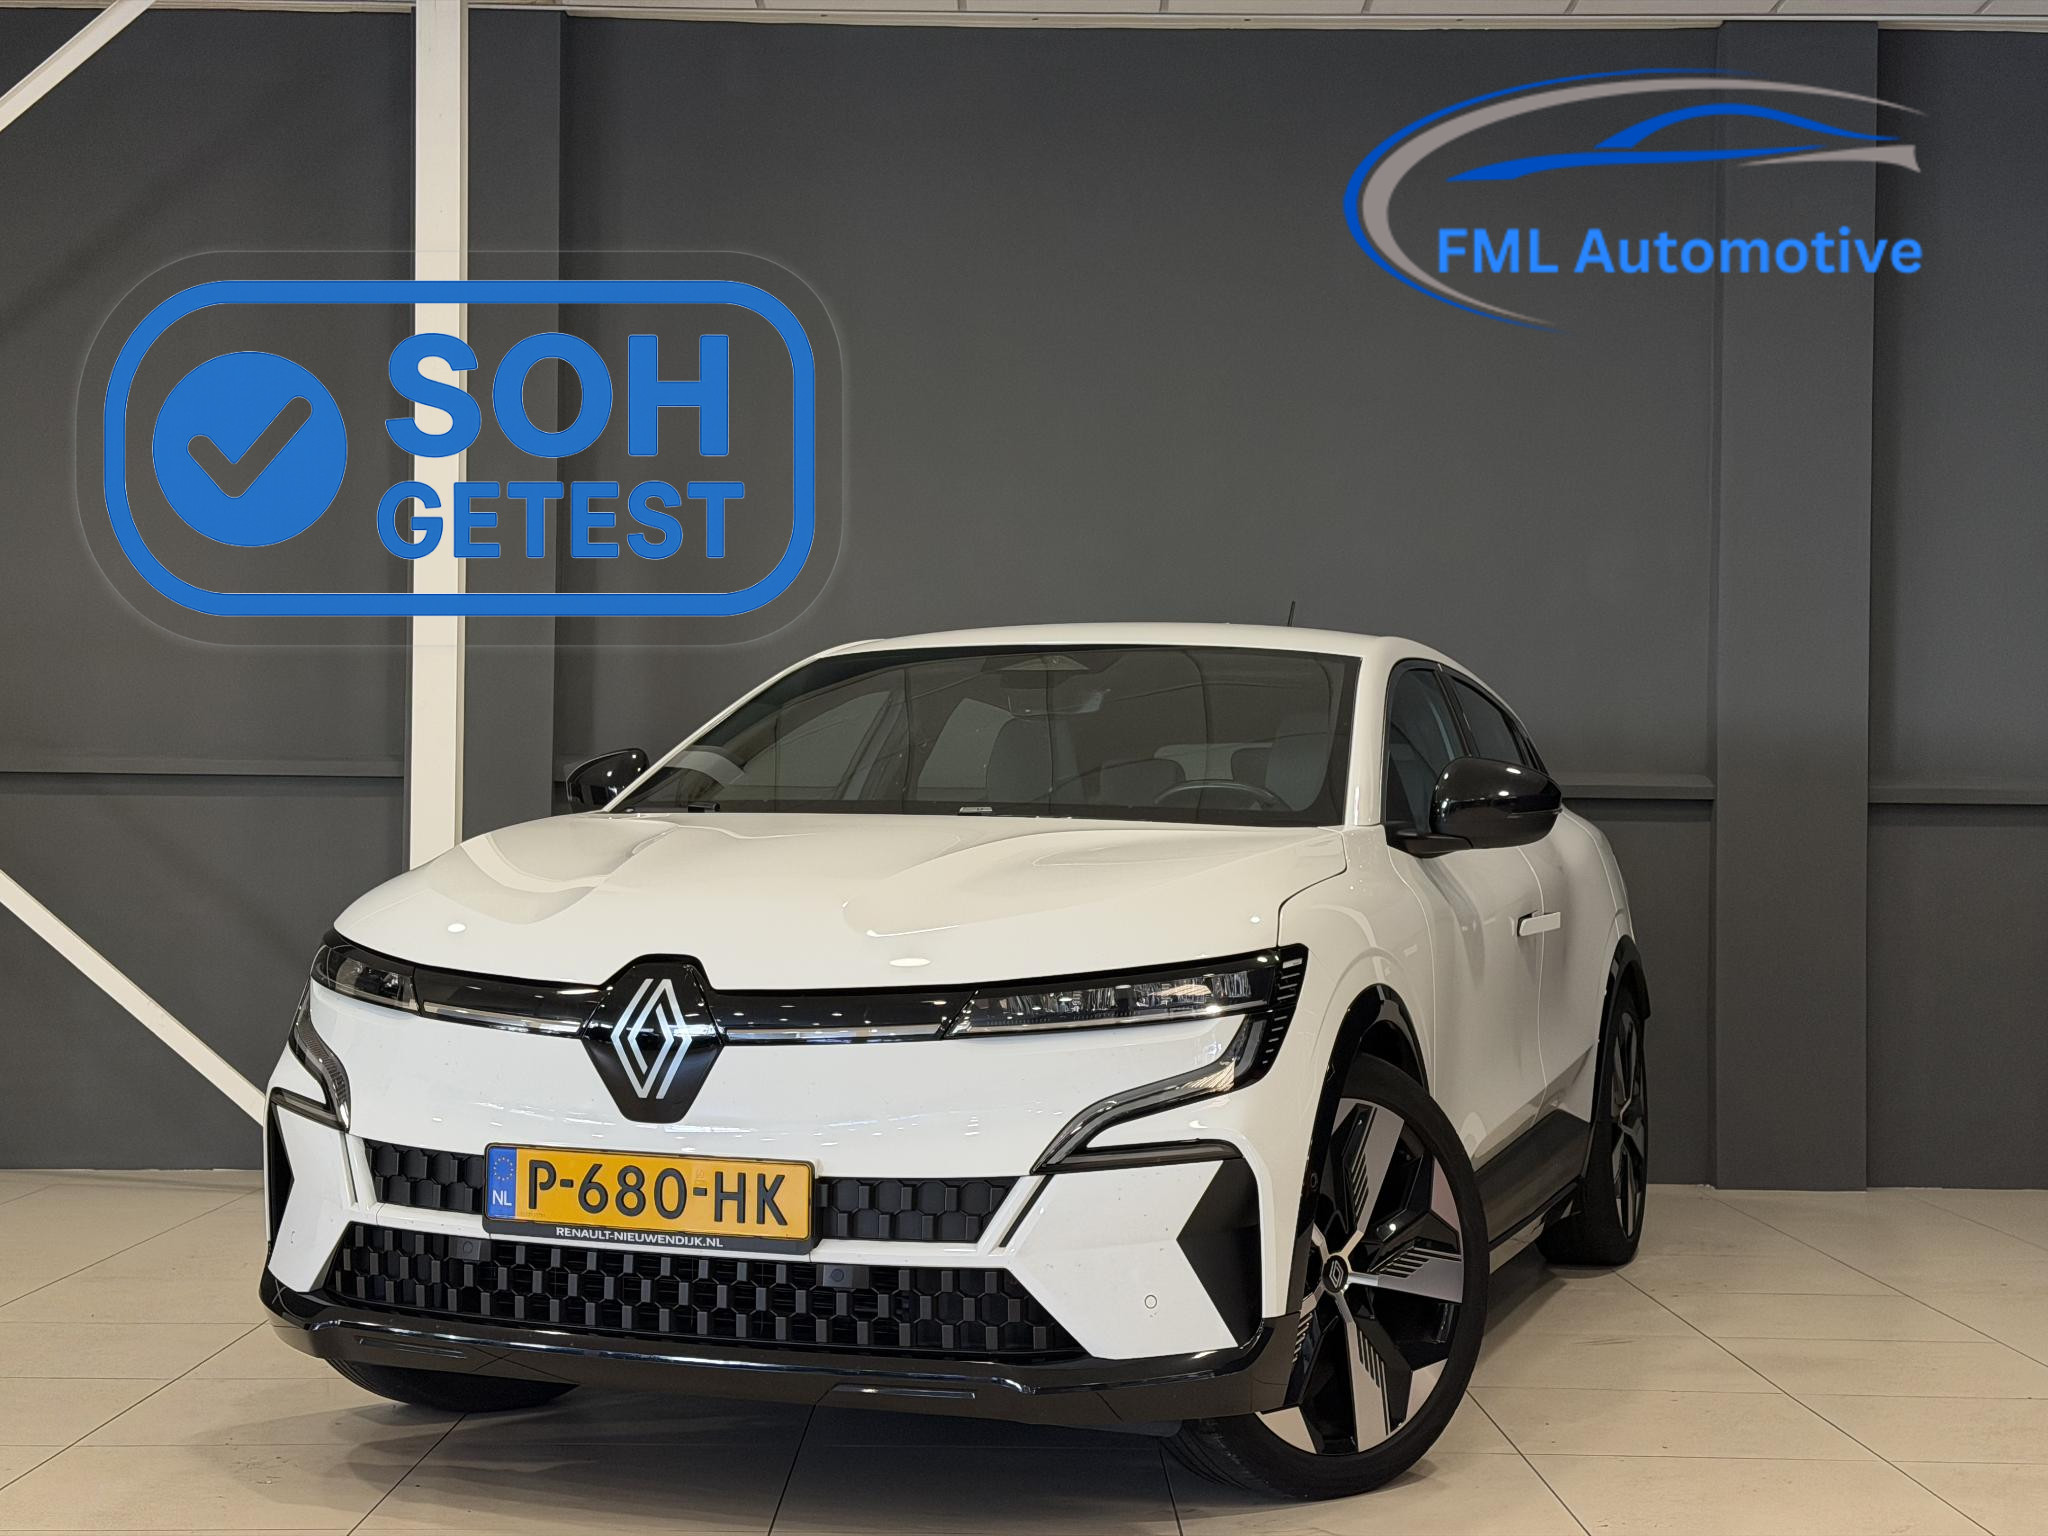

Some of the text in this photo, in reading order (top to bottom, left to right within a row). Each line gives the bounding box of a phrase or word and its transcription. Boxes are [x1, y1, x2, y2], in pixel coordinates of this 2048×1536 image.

[492, 1159, 788, 1226] NL P-680-HK
[555, 1226, 724, 1248] RENAULT-NIEUWENDIJK.NL
